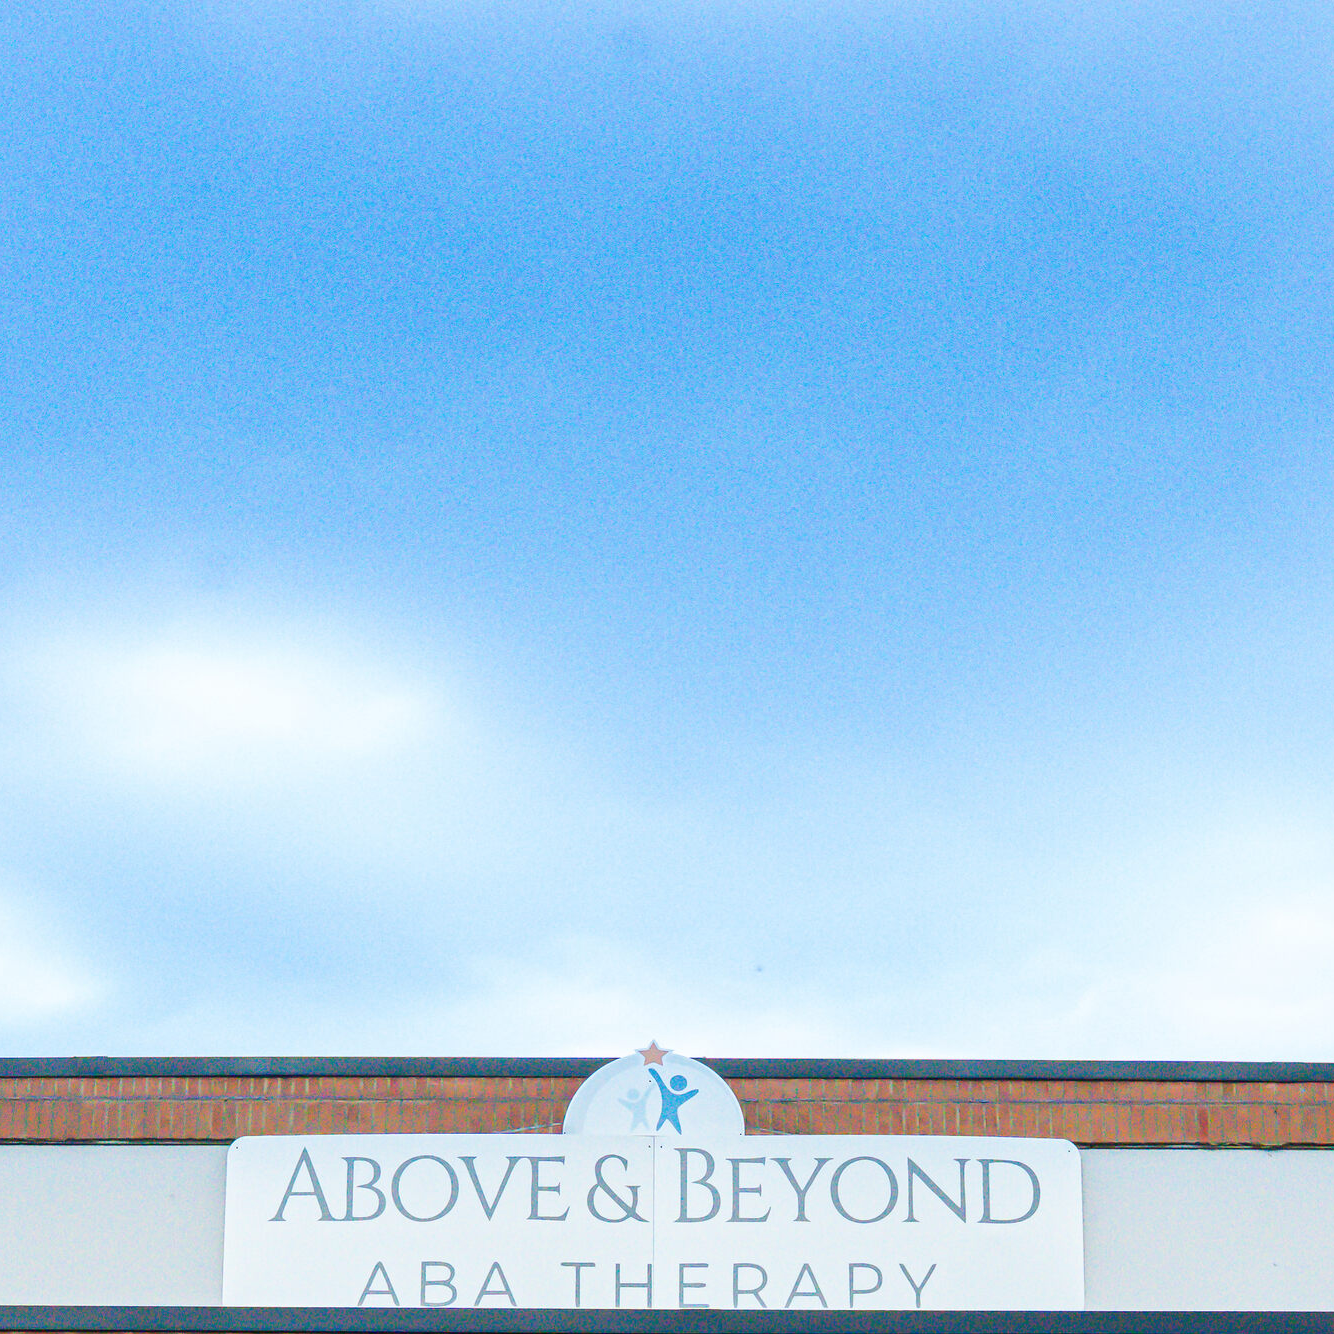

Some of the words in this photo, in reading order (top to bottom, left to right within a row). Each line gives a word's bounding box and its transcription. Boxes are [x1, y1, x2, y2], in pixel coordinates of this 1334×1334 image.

[267, 1146, 571, 1223] ABOVE
[586, 1153, 650, 1223] &
[673, 1147, 1041, 1224] BEYOND
[357, 1260, 517, 1307] ABA
[560, 1262, 937, 1309] THERAPY
